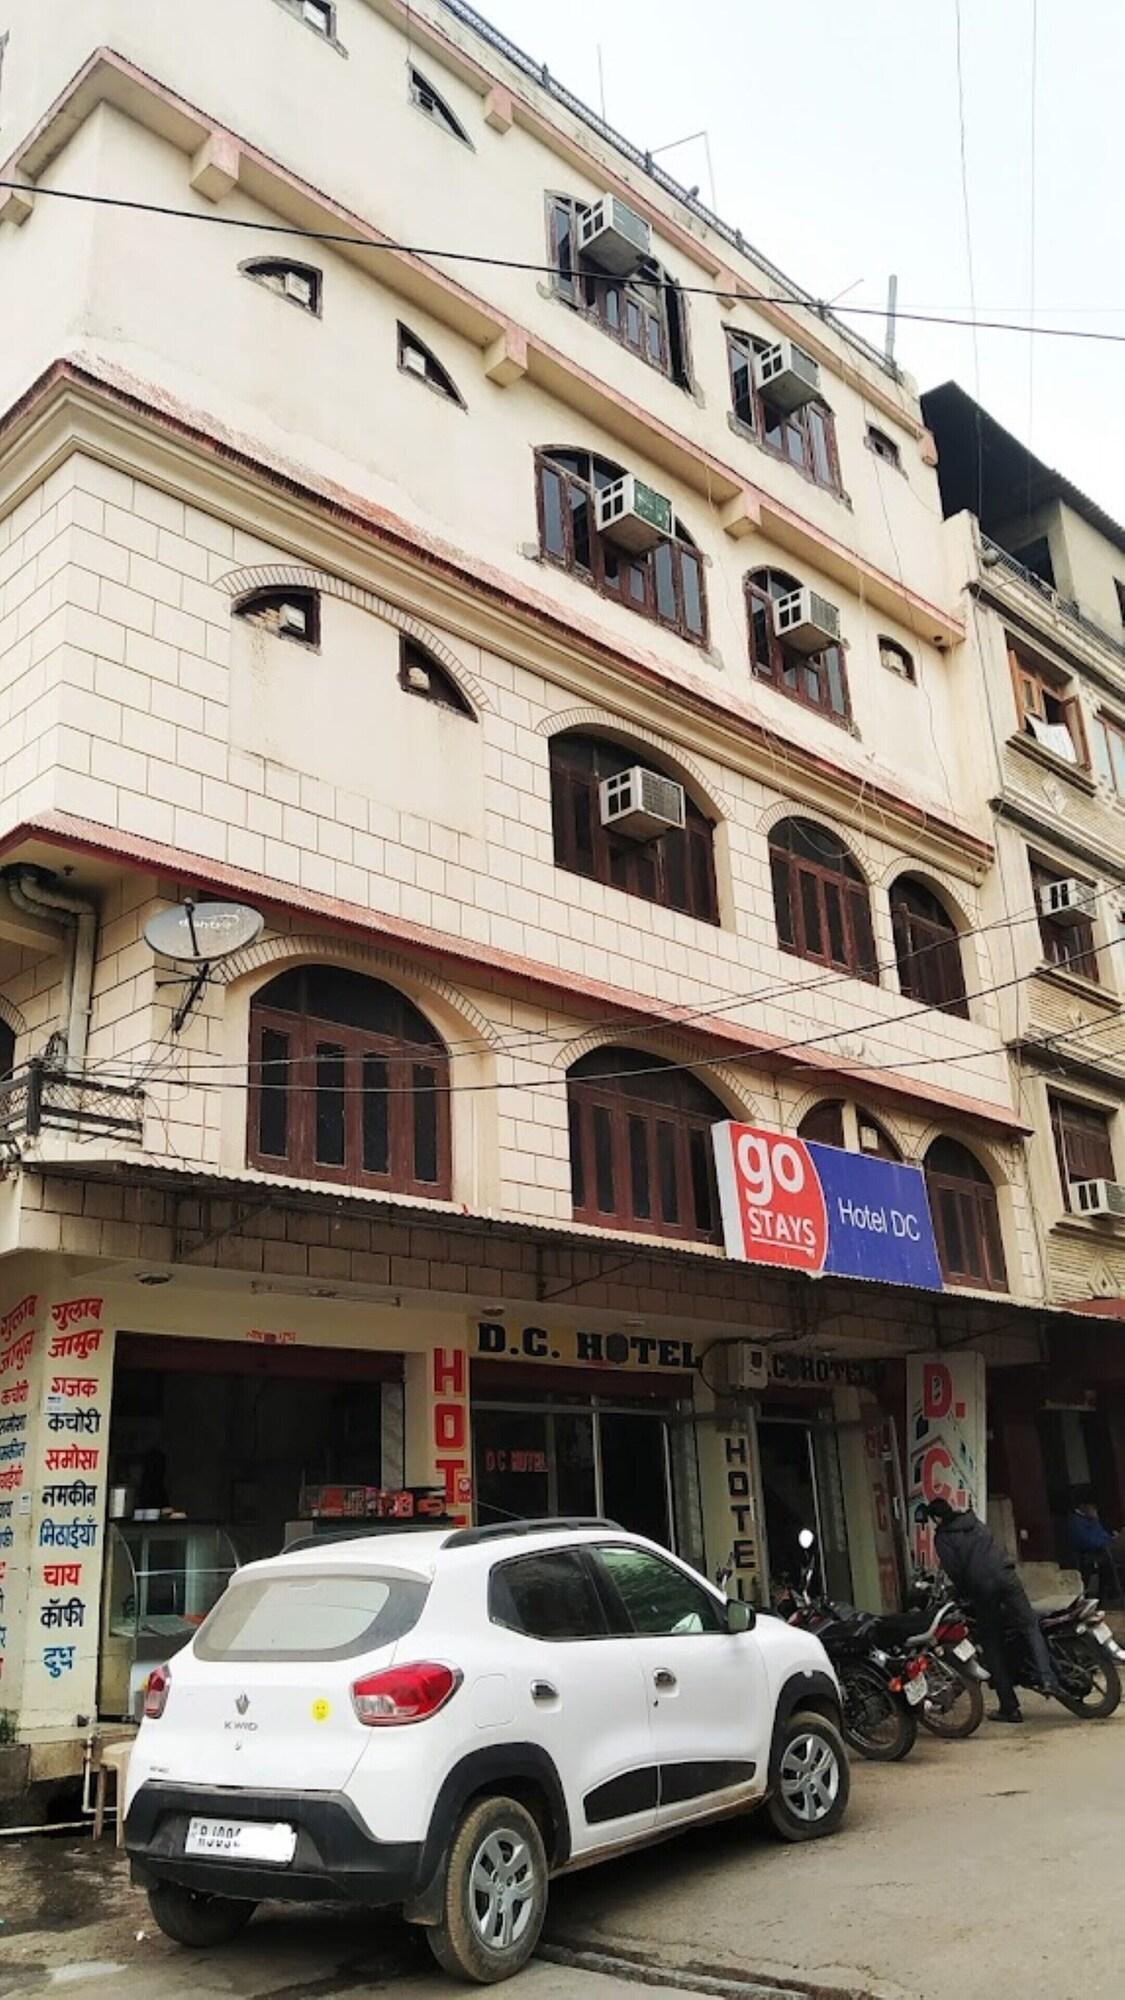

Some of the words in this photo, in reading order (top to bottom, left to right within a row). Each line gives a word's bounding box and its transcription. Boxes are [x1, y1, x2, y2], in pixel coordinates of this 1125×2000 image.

[737, 1134, 804, 1206] go
[748, 1207, 816, 1246] STAYS
[837, 1197, 887, 1234] Hotel
[891, 1210, 921, 1242] DC
[51, 1298, 104, 1331] गुलाब
[48, 1328, 104, 1359] जामुन
[478, 1322, 561, 1357] D.C.
[576, 1331, 701, 1369] HOTEL
[51, 1376, 99, 1398] गजक
[45, 1407, 101, 1433] कचोरी
[433, 1347, 466, 1526] HOT
[45, 1443, 99, 1471] समोसा
[42, 1480, 98, 1507] नमकीन
[44, 1564, 82, 1586] चाय
[40, 1597, 86, 1628] कॉफी
